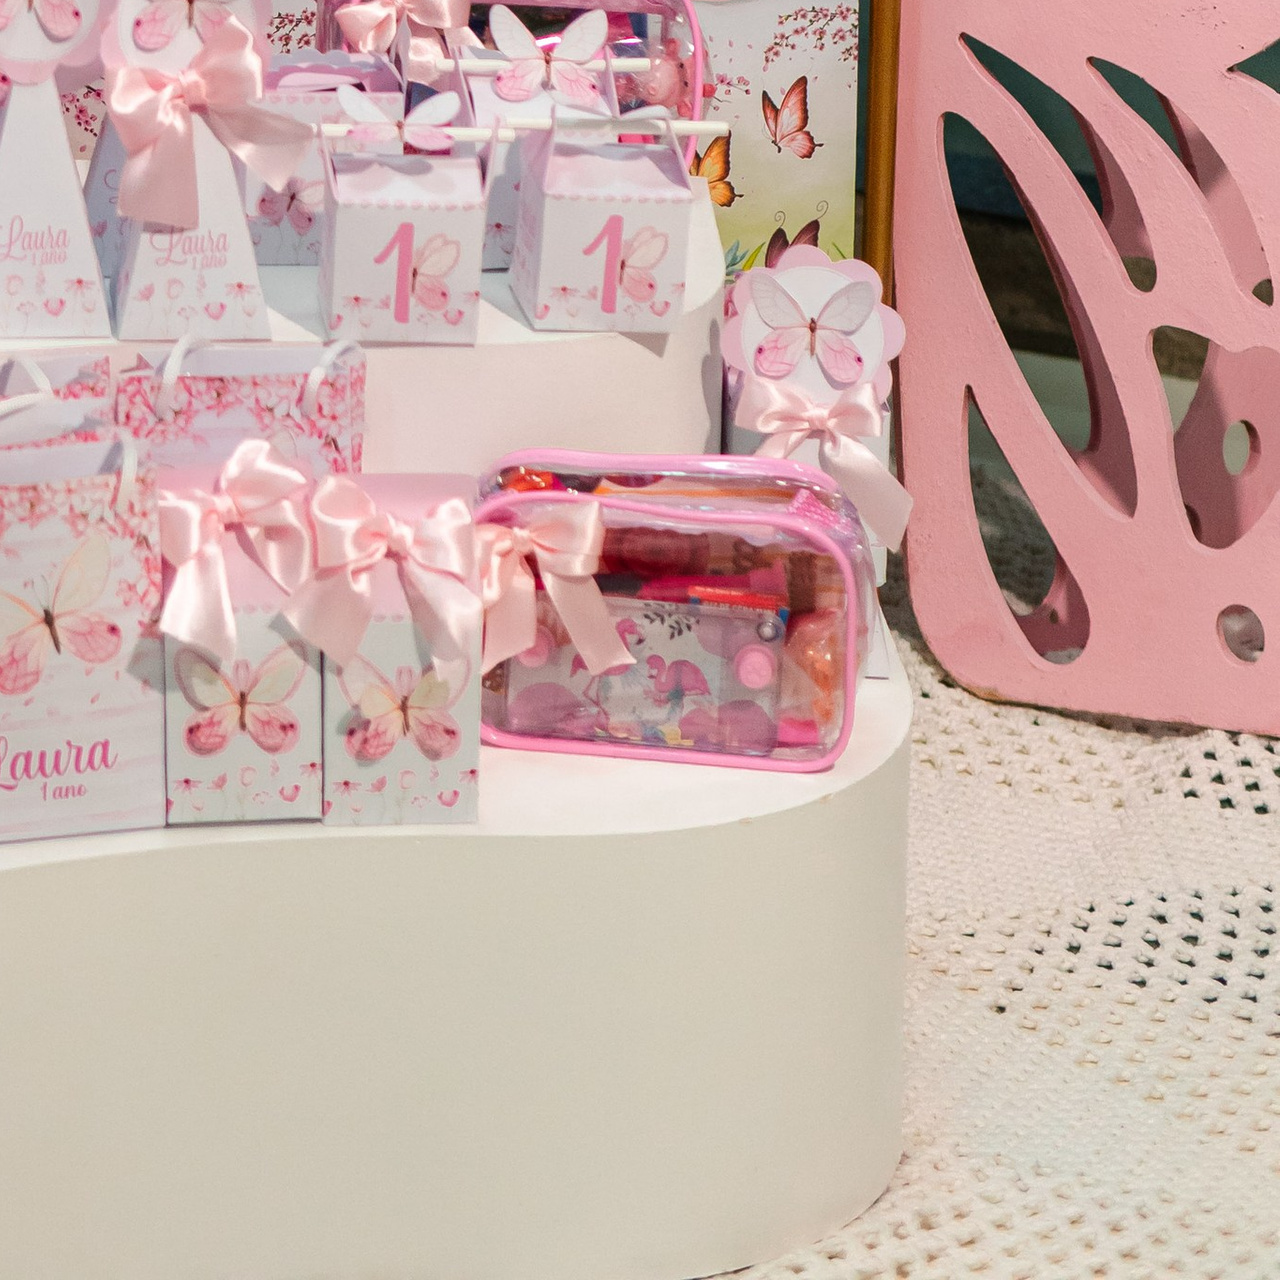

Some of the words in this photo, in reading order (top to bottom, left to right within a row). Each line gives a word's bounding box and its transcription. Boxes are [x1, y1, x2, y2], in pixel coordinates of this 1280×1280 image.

[374, 221, 415, 325] 1
[583, 214, 625, 315] 1
[40, 781, 47, 801] 1
[52, 784, 87, 799] ano
